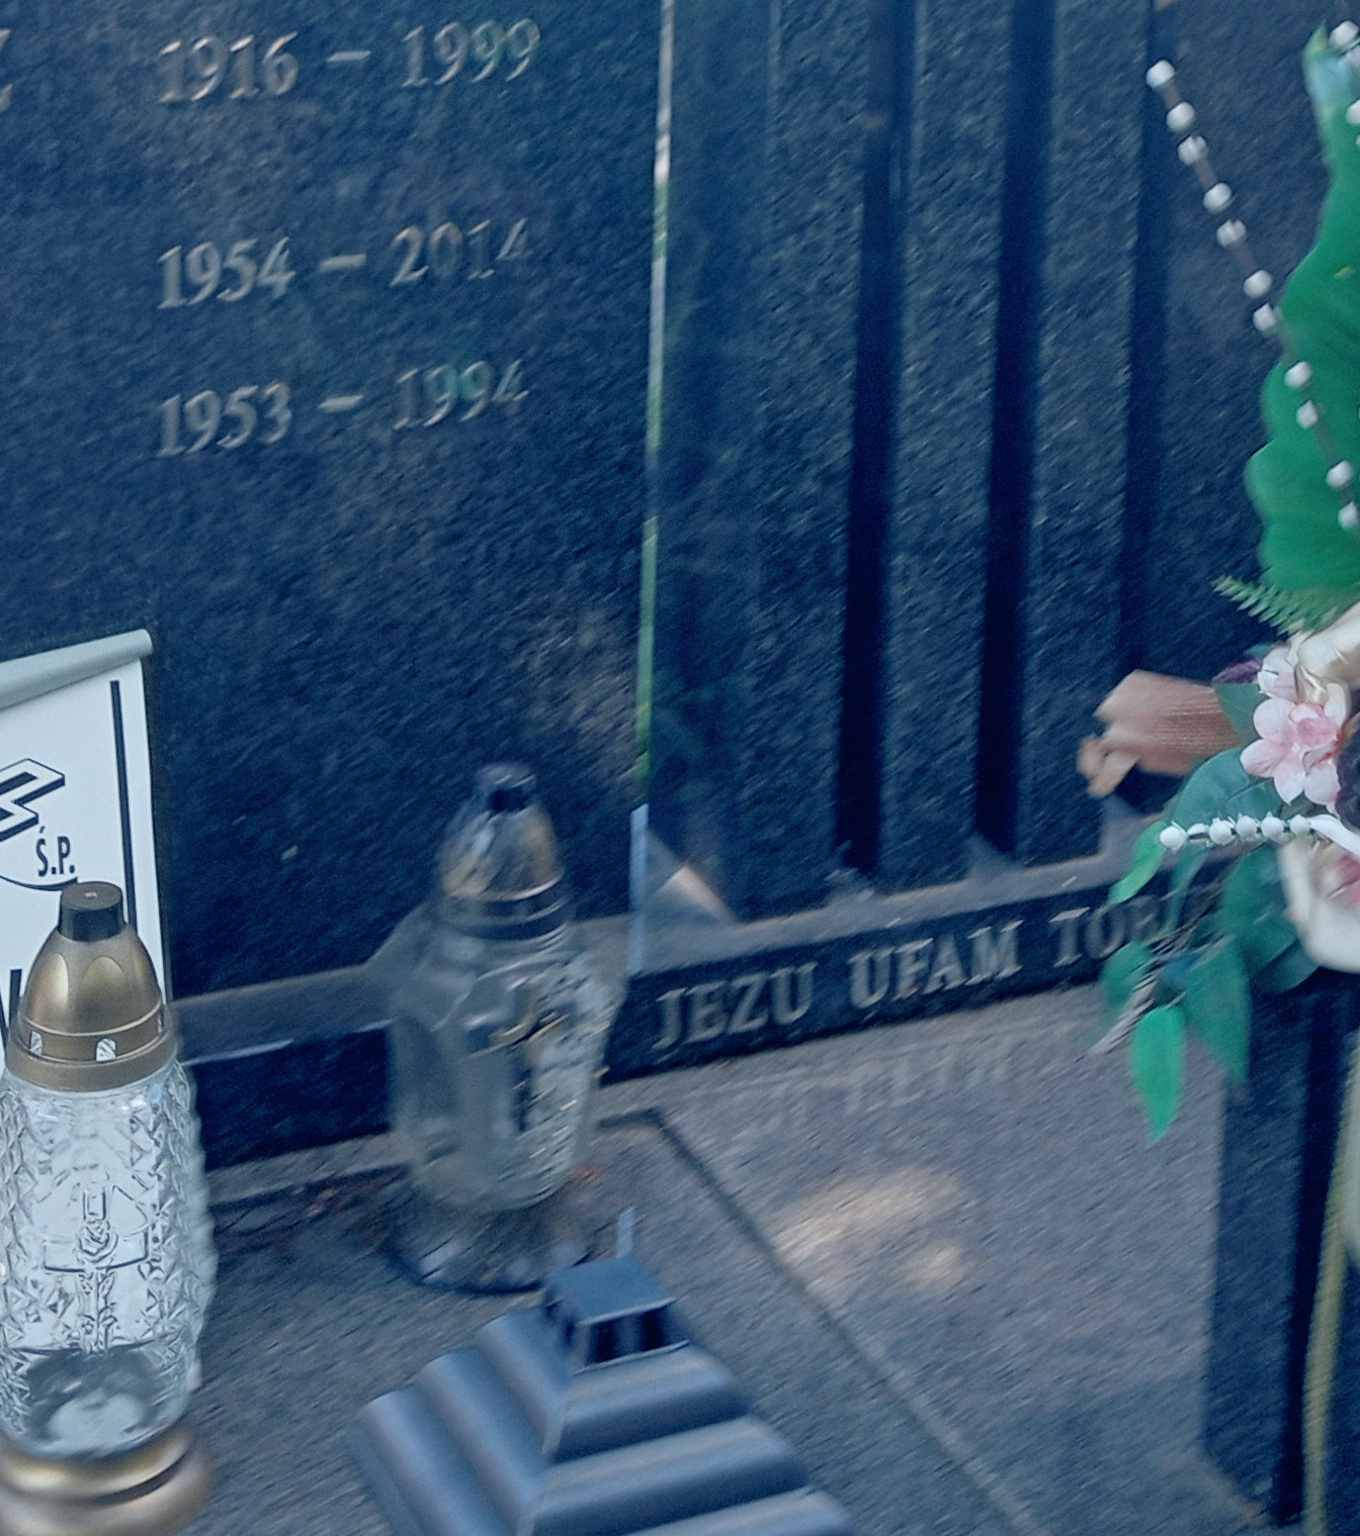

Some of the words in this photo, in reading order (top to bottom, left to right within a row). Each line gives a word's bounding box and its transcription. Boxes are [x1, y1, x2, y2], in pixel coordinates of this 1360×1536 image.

[158, 30, 299, 104] 1916
[400, 17, 541, 89] 1999
[157, 236, 296, 310] 1954
[389, 216, 532, 288] 2014
[157, 380, 292, 458] 1953
[393, 359, 530, 432] 1994
[34, 825, 77, 878] Ś.P.
[651, 962, 819, 1051] JEZU
[847, 918, 1025, 1009] UFAM
